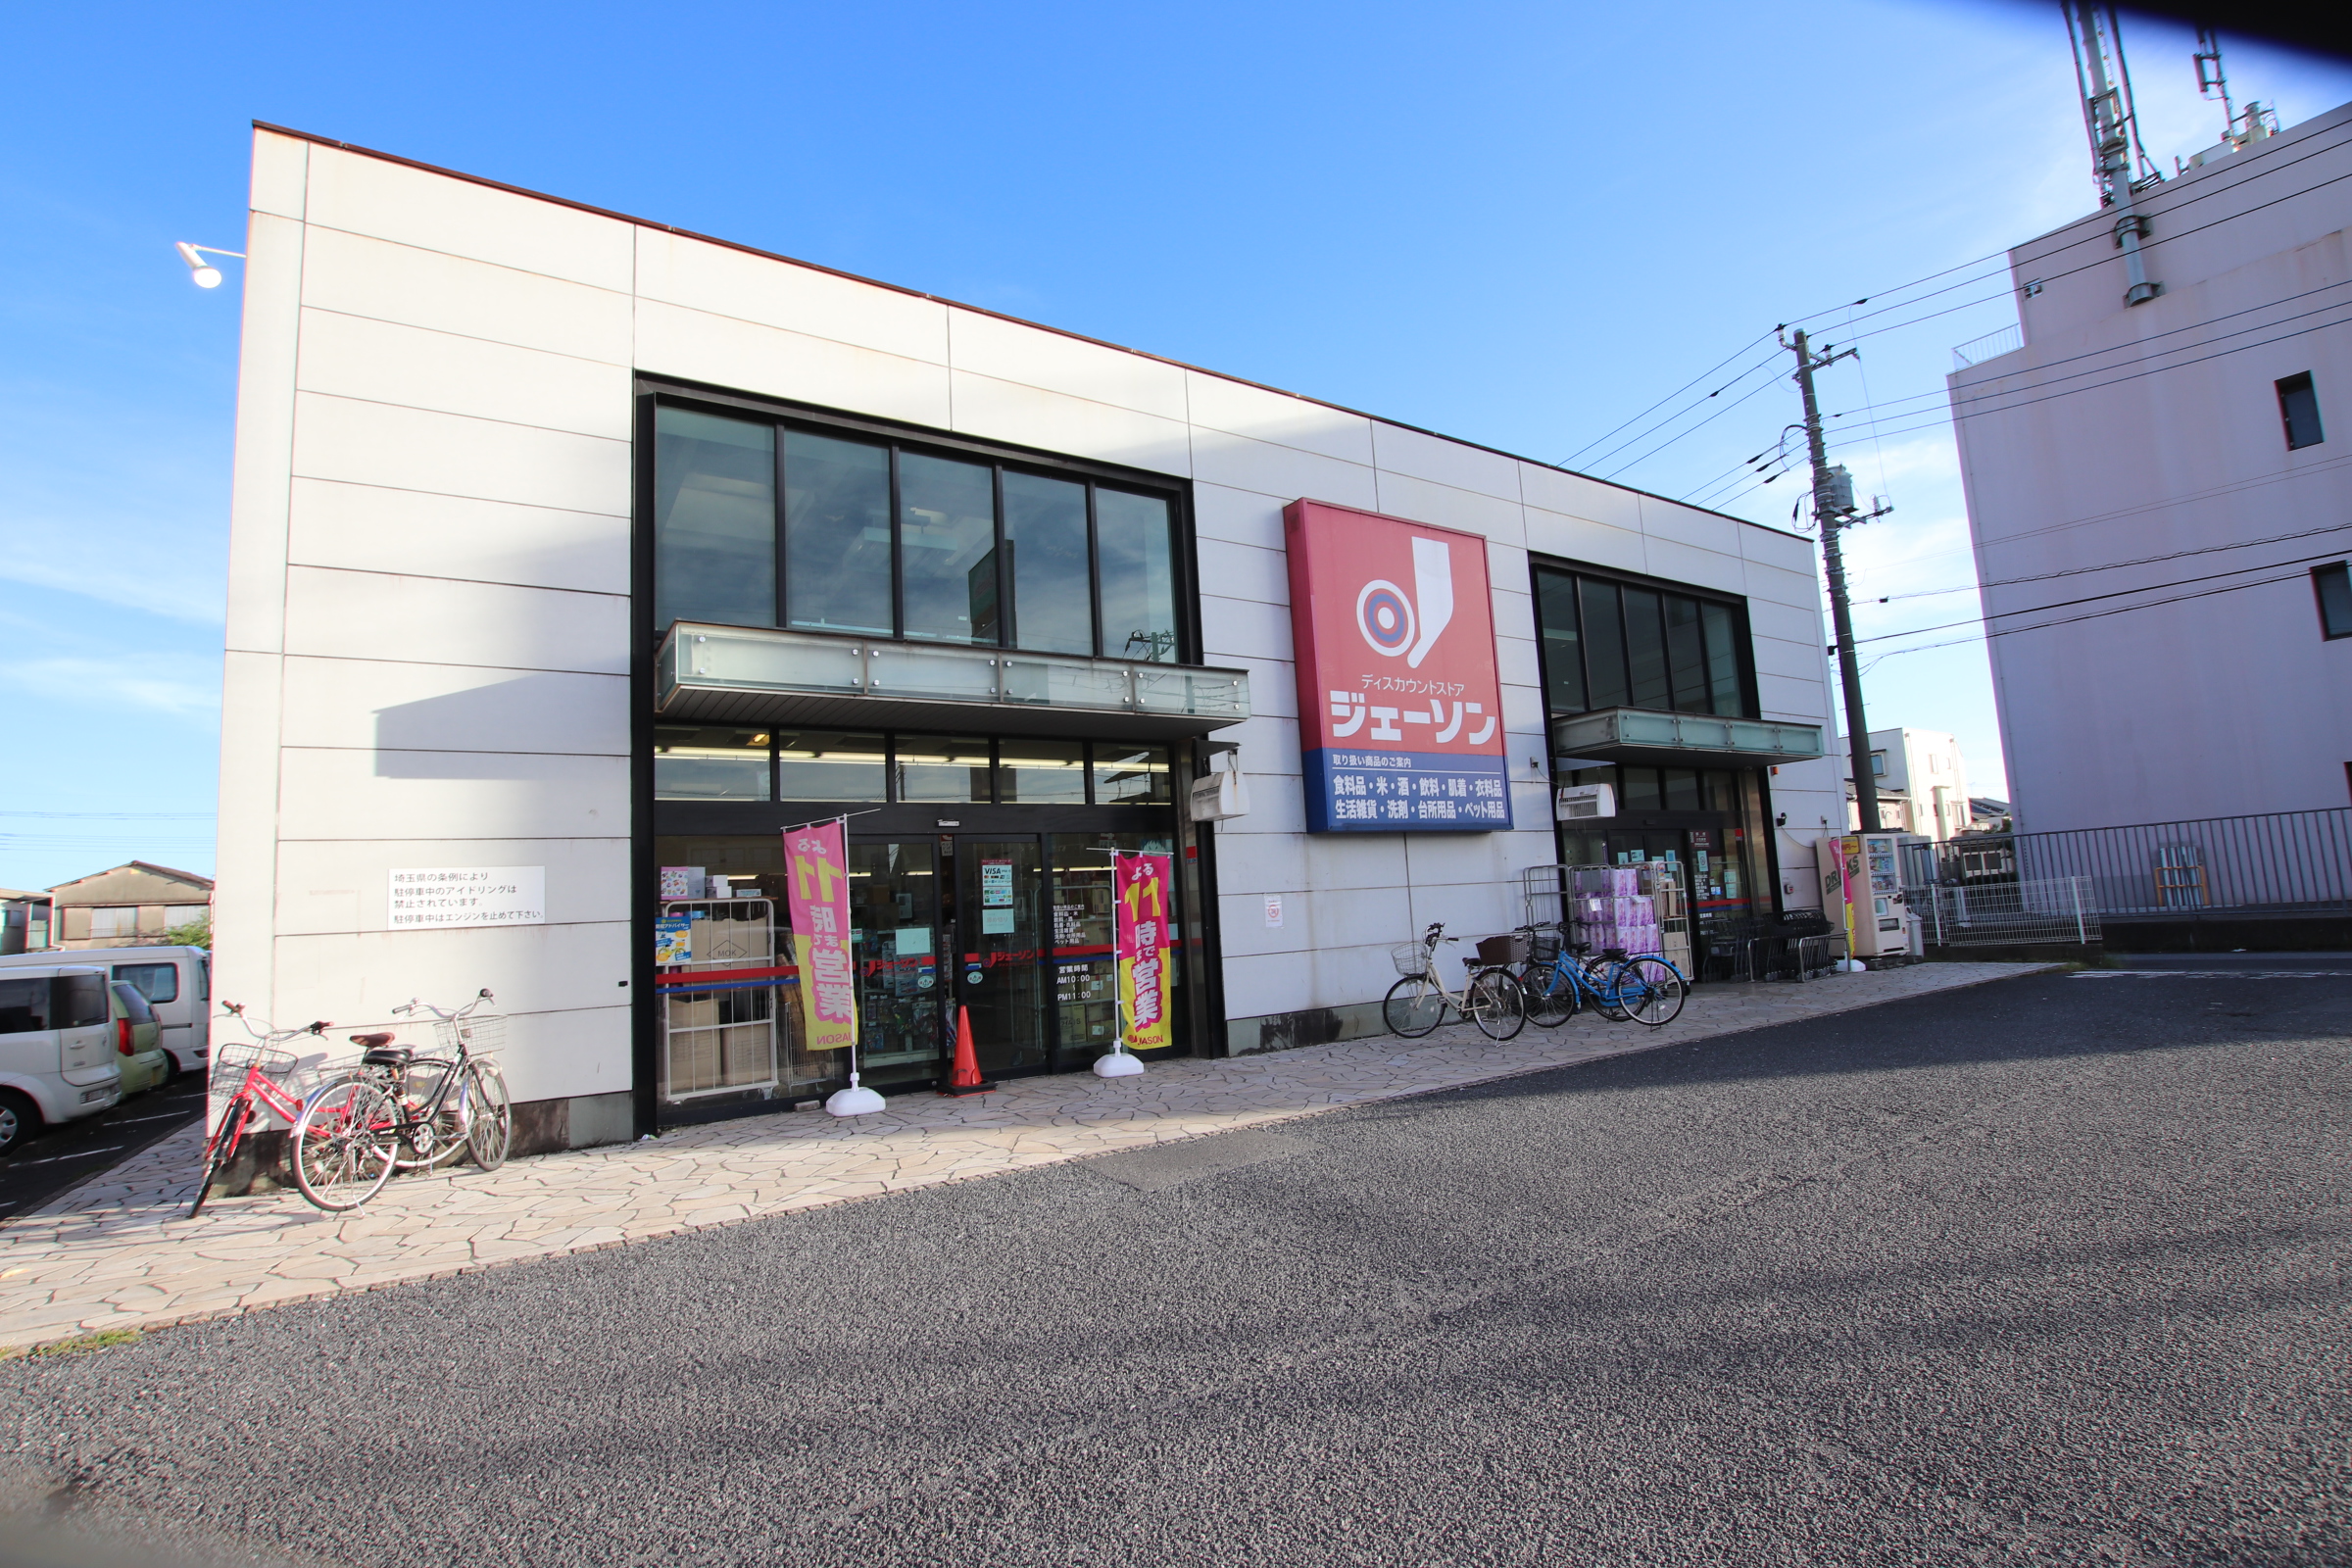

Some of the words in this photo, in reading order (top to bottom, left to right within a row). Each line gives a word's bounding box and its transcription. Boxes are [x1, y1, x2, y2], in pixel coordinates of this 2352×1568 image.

[1361, 674, 1465, 697] ディスカウントストア
[1330, 690, 1495, 745] ジェーソン
[1333, 754, 1411, 768] 取り扱い商品のご案内
[394, 872, 489, 882] 埼玉県の条例により
[1825, 856, 1859, 889] DRKS
[394, 885, 517, 897] 駐停車中のアイドリングは
[394, 898, 483, 908] 禁止されています。
[394, 910, 544, 924] 駐停車中はエンジンを止めて下さい。
[1058, 964, 1088, 973] 営業時間
[1137, 1034, 1163, 1045] JASON
